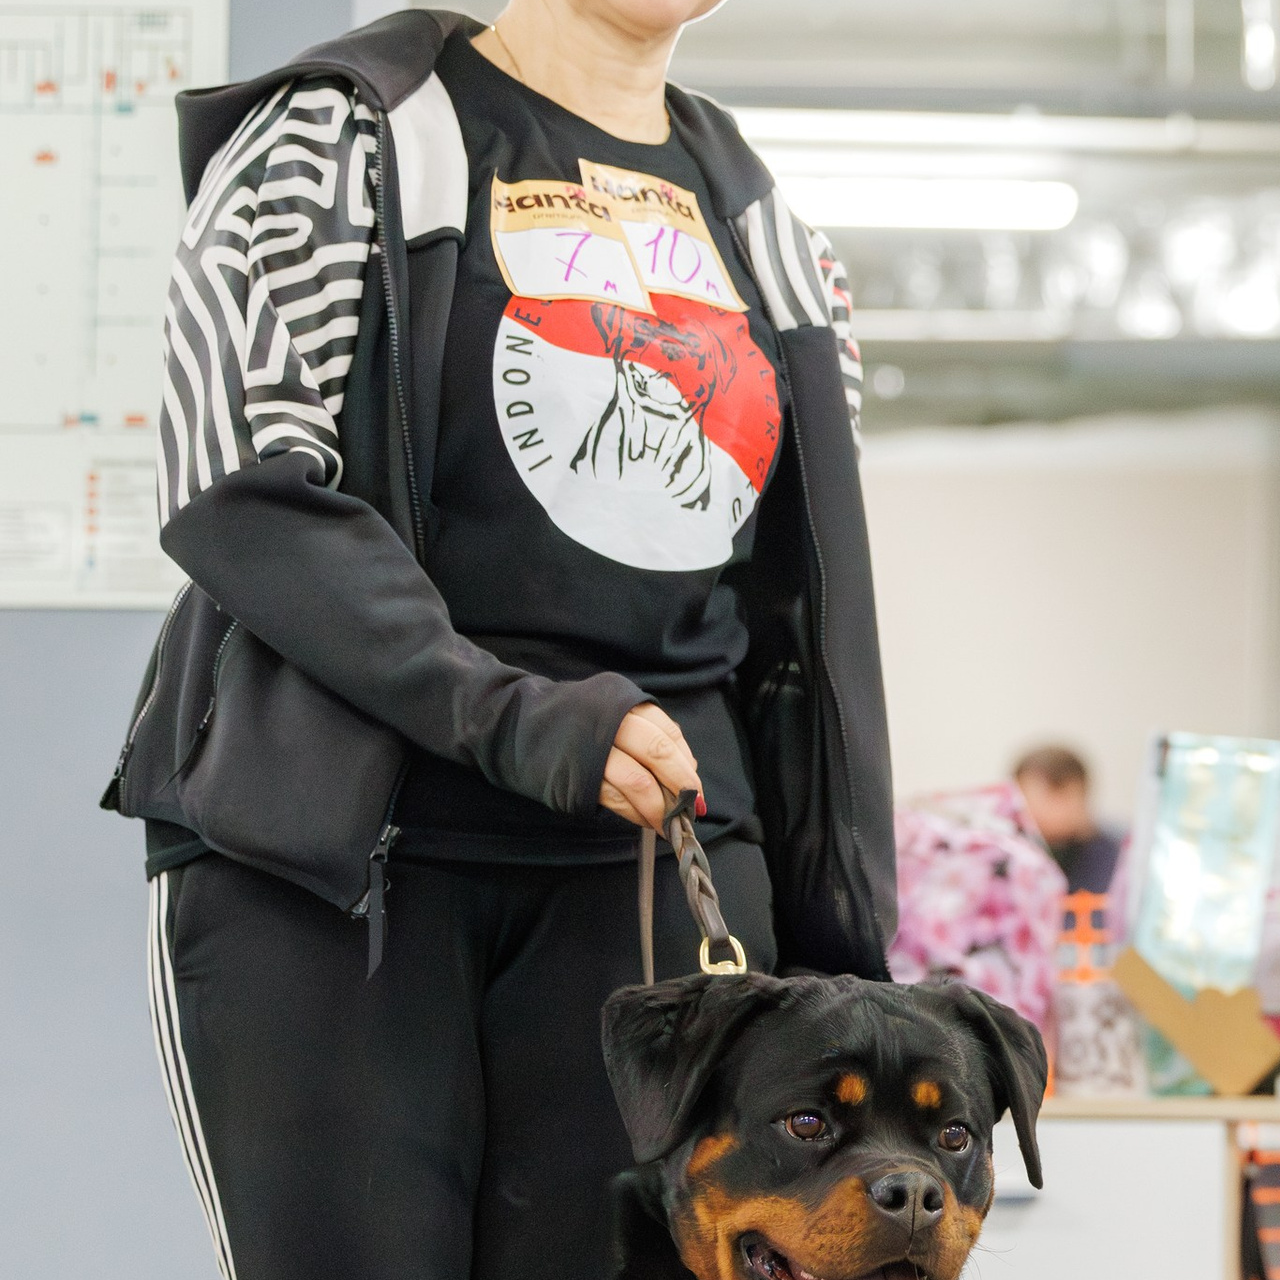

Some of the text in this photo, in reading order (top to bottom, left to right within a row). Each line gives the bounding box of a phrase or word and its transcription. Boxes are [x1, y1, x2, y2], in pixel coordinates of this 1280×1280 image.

[555, 232, 592, 282] 7
[645, 227, 701, 284] 10
[502, 300, 554, 472] INDONE
